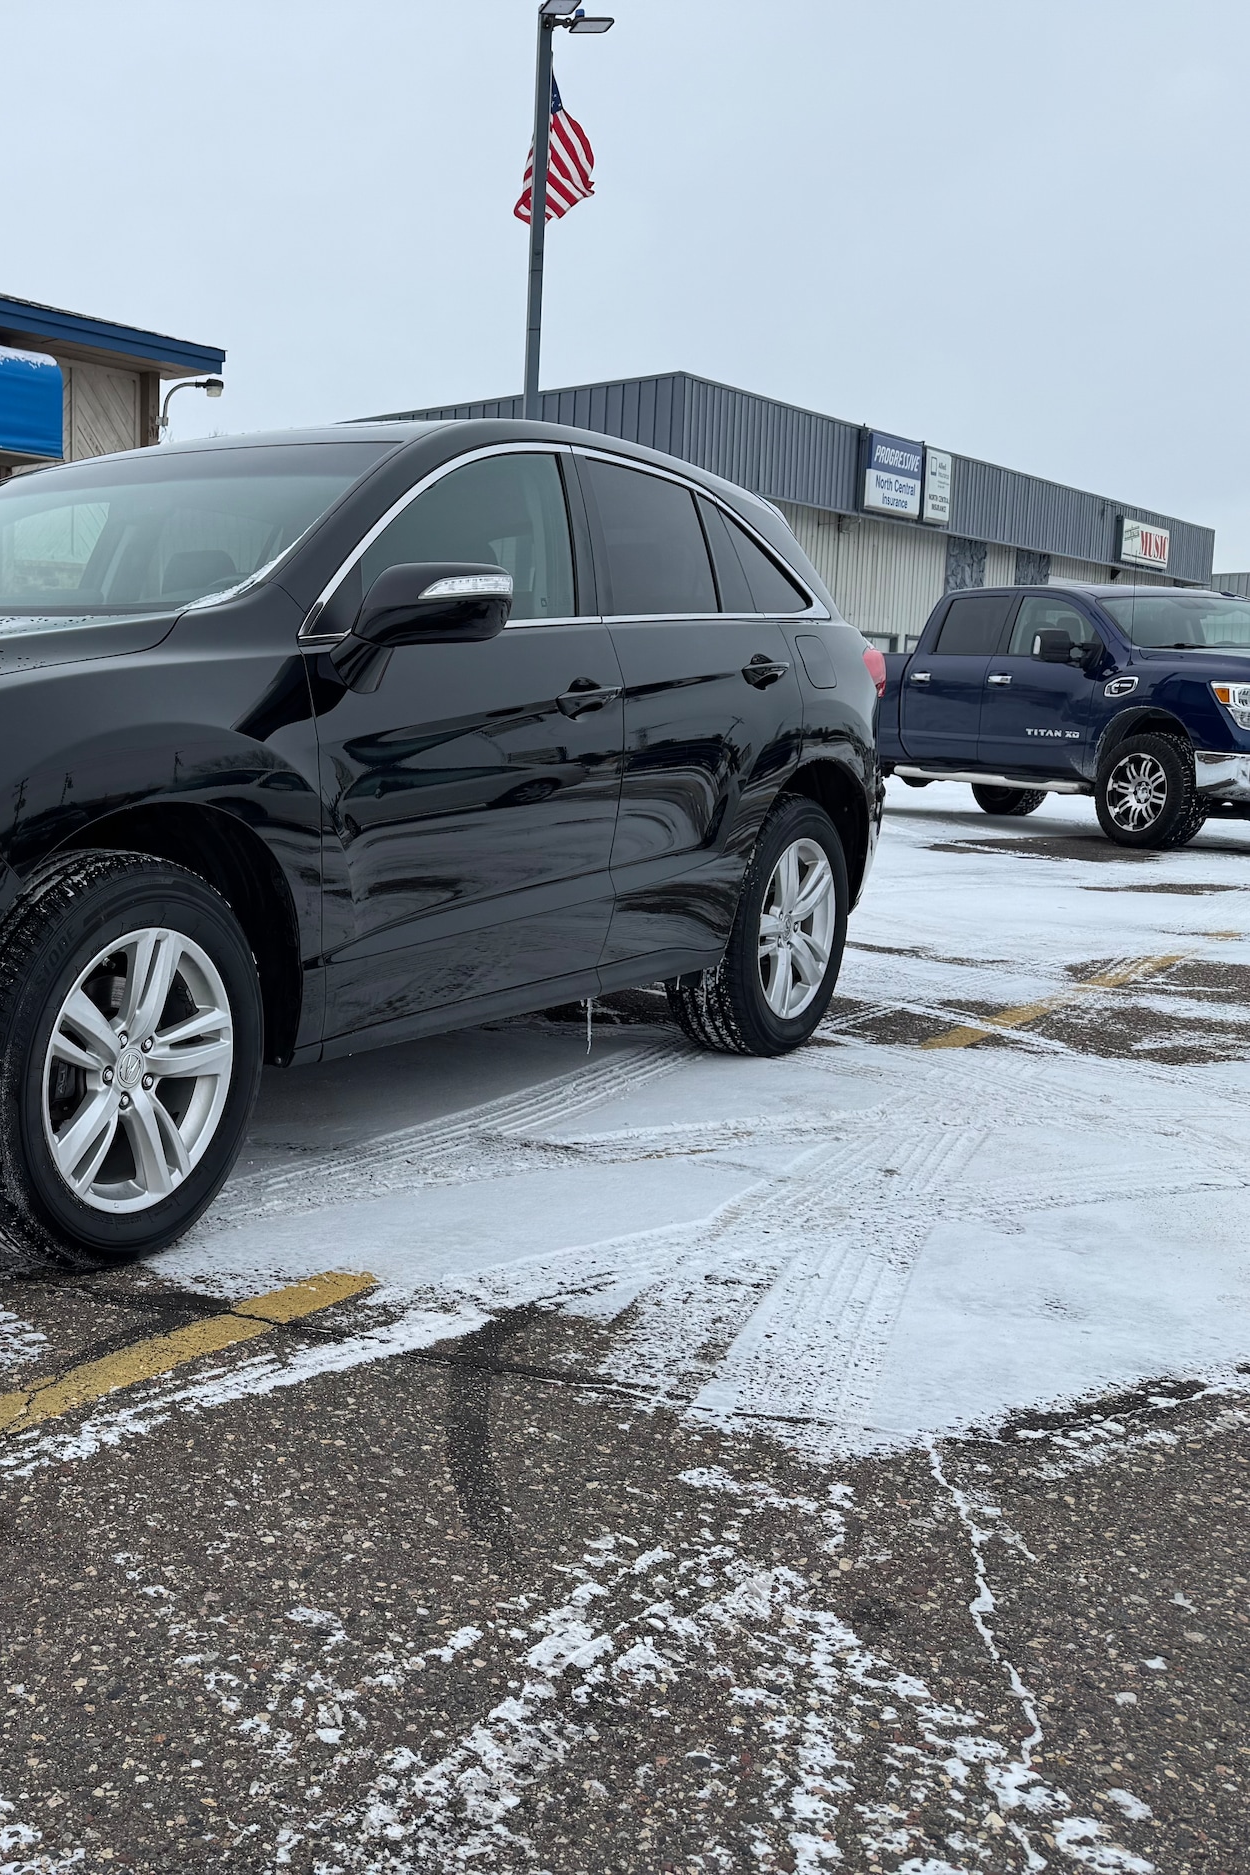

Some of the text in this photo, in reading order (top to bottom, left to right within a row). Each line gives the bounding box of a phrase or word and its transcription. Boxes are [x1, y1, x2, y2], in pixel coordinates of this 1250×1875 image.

[874, 444, 920, 472] PROGRESSIVE
[875, 474, 915, 496] North Central
[882, 493, 908, 509] Insurance
[1140, 530, 1168, 561] MUSIC
[1026, 728, 1062, 737] TITAN
